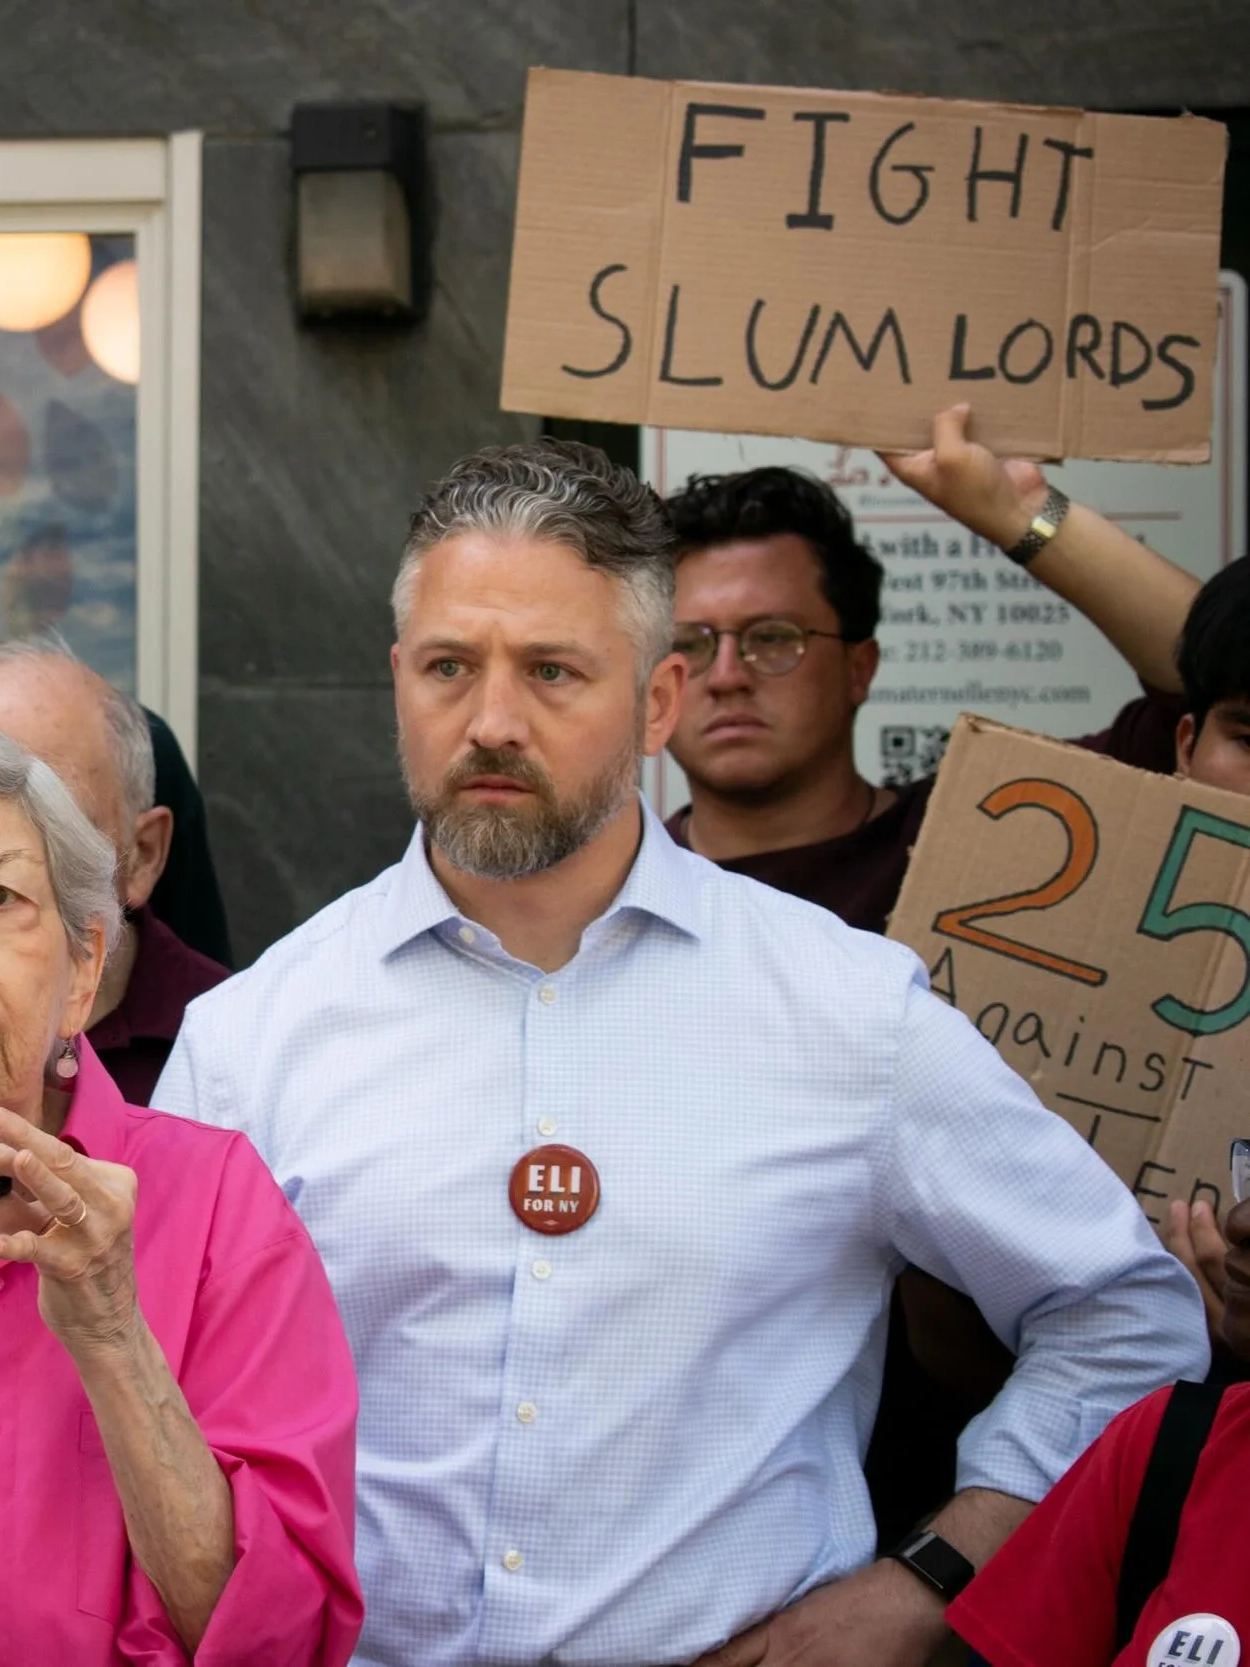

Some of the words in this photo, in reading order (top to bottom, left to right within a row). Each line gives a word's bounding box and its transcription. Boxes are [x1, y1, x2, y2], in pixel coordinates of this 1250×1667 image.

[676, 102, 1094, 231] FIGHT
[879, 530, 939, 557] with
[947, 537, 962, 556] a
[883, 572, 922, 591] est
[930, 567, 988, 590] 97th
[880, 604, 939, 628] ork,
[948, 603, 987, 624] NY
[996, 602, 1069, 624] 10025
[528, 1165, 581, 1193] ELI
[523, 1199, 554, 1212] FOR
[559, 1200, 579, 1213] NY
[1168, 1630, 1224, 1665] ELI
